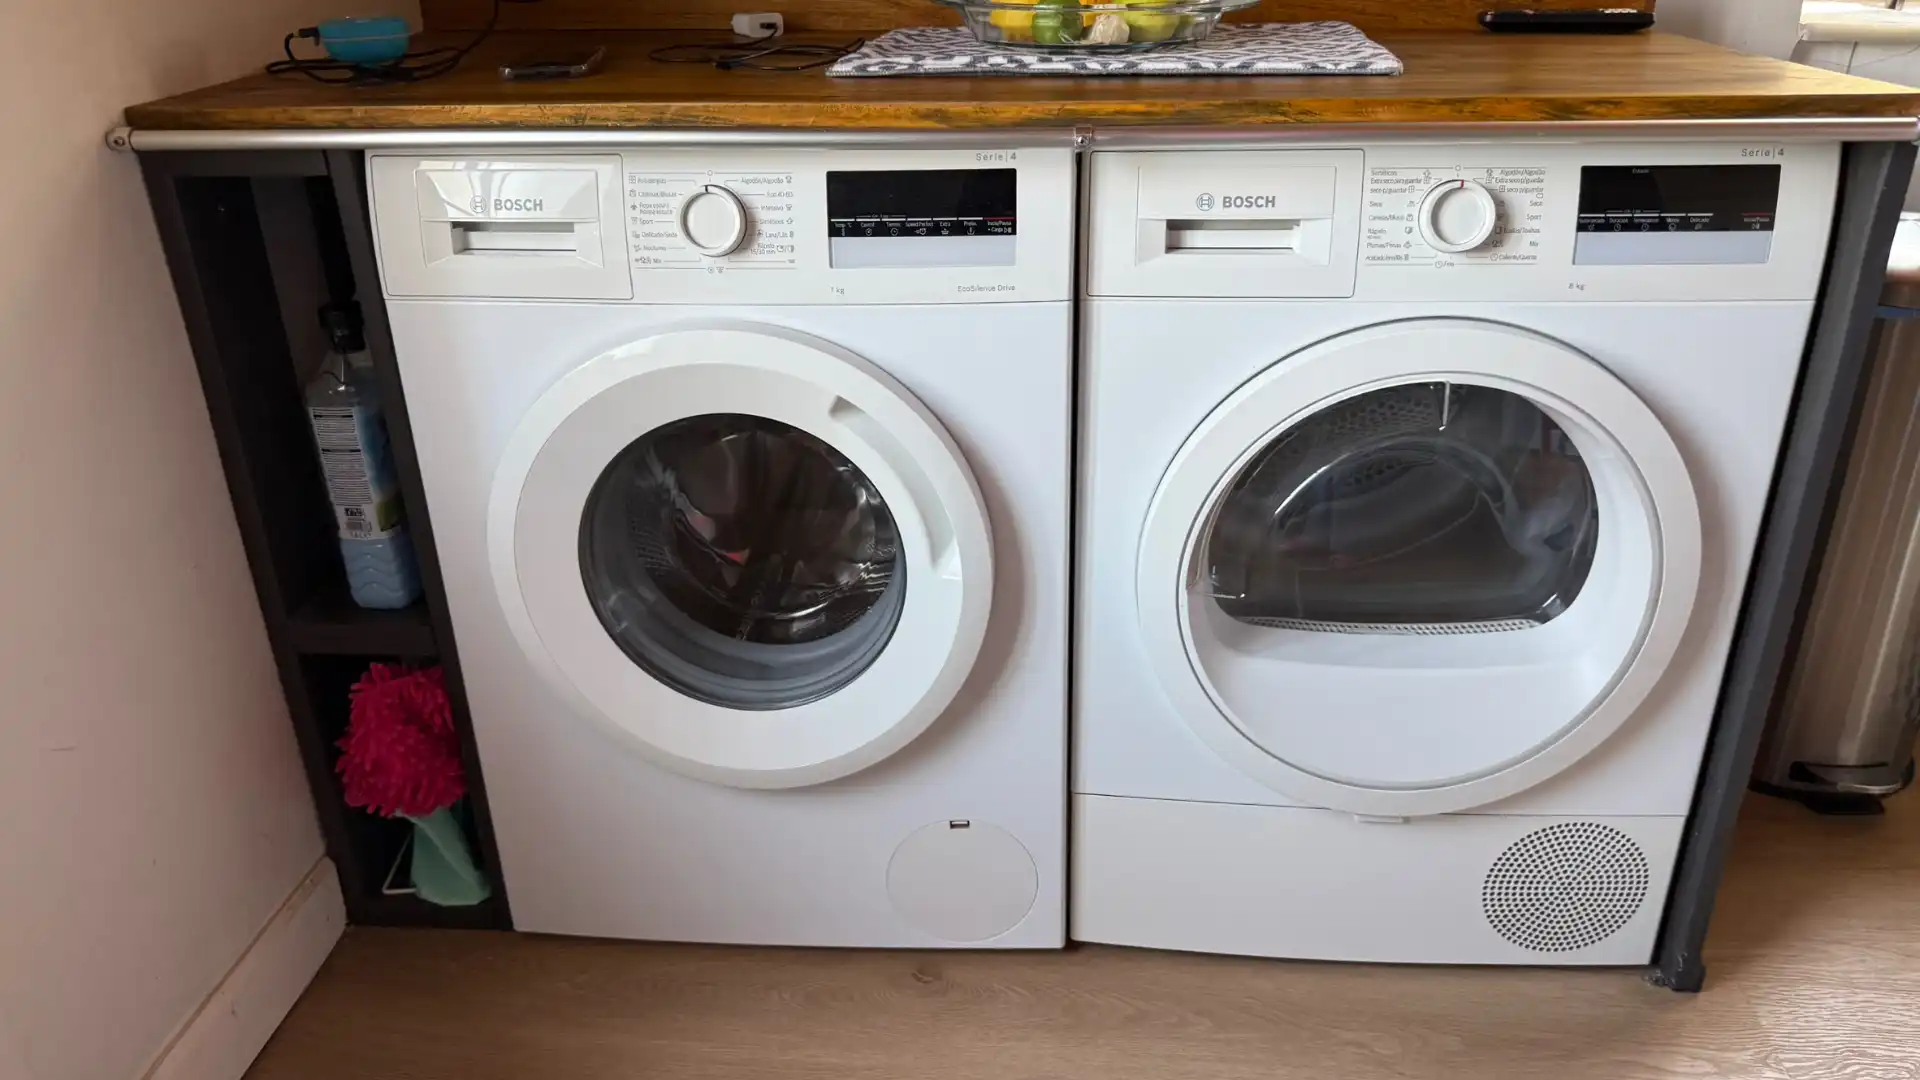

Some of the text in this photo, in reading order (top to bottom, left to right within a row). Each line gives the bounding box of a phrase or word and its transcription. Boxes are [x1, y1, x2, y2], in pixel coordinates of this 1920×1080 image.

[494, 198, 544, 212] BOSCH
[1222, 195, 1277, 209] BOSCH
[997, 284, 1016, 292] Drive
